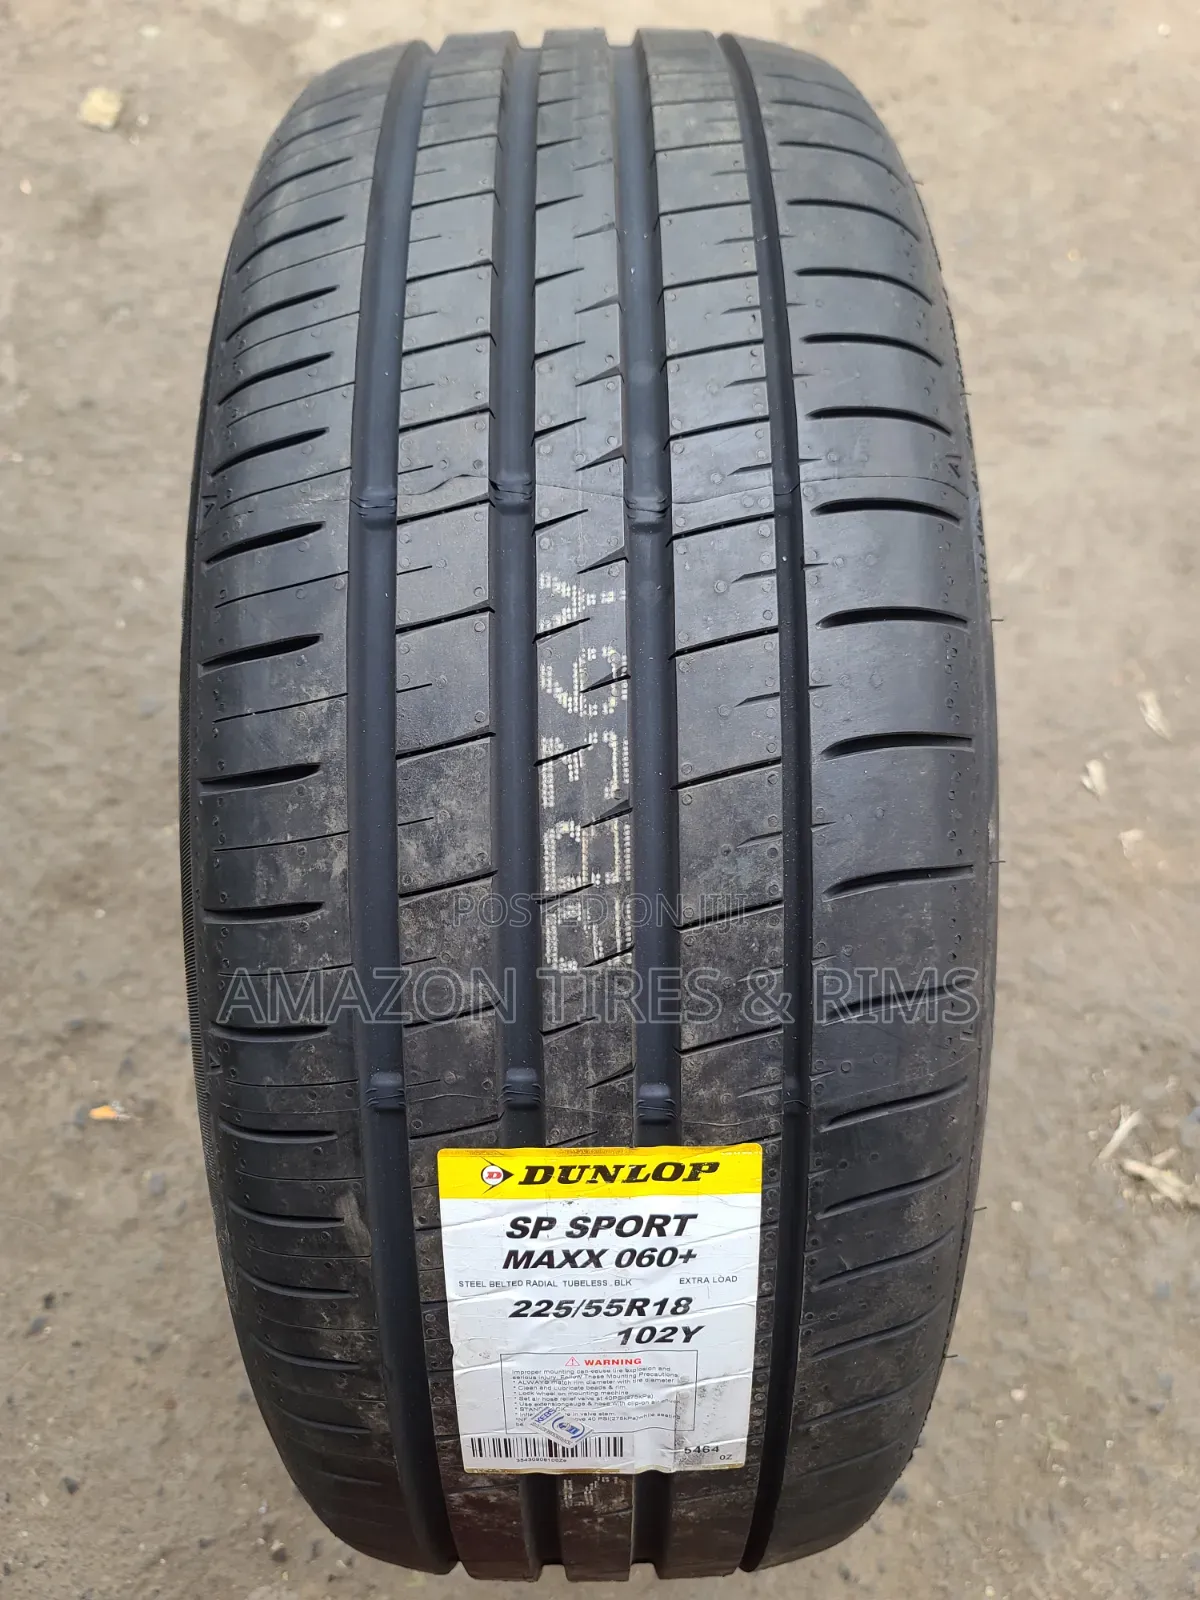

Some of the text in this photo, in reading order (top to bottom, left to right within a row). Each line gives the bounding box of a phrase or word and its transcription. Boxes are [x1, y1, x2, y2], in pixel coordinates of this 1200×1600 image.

[517, 1161, 720, 1186] DUNLOP
[505, 1213, 699, 1240] SP SPORT
[502, 1246, 698, 1270] MAXX 060+
[458, 1278, 632, 1288] STEEL BELTED RADIAL TUBELESS BLK
[679, 1274, 739, 1285] EXTRA LOAD
[508, 1296, 694, 1319] 225/55R18
[616, 1324, 705, 1346] 102Y
[584, 1358, 642, 1367] WARNING
[684, 1445, 720, 1455] 5464
